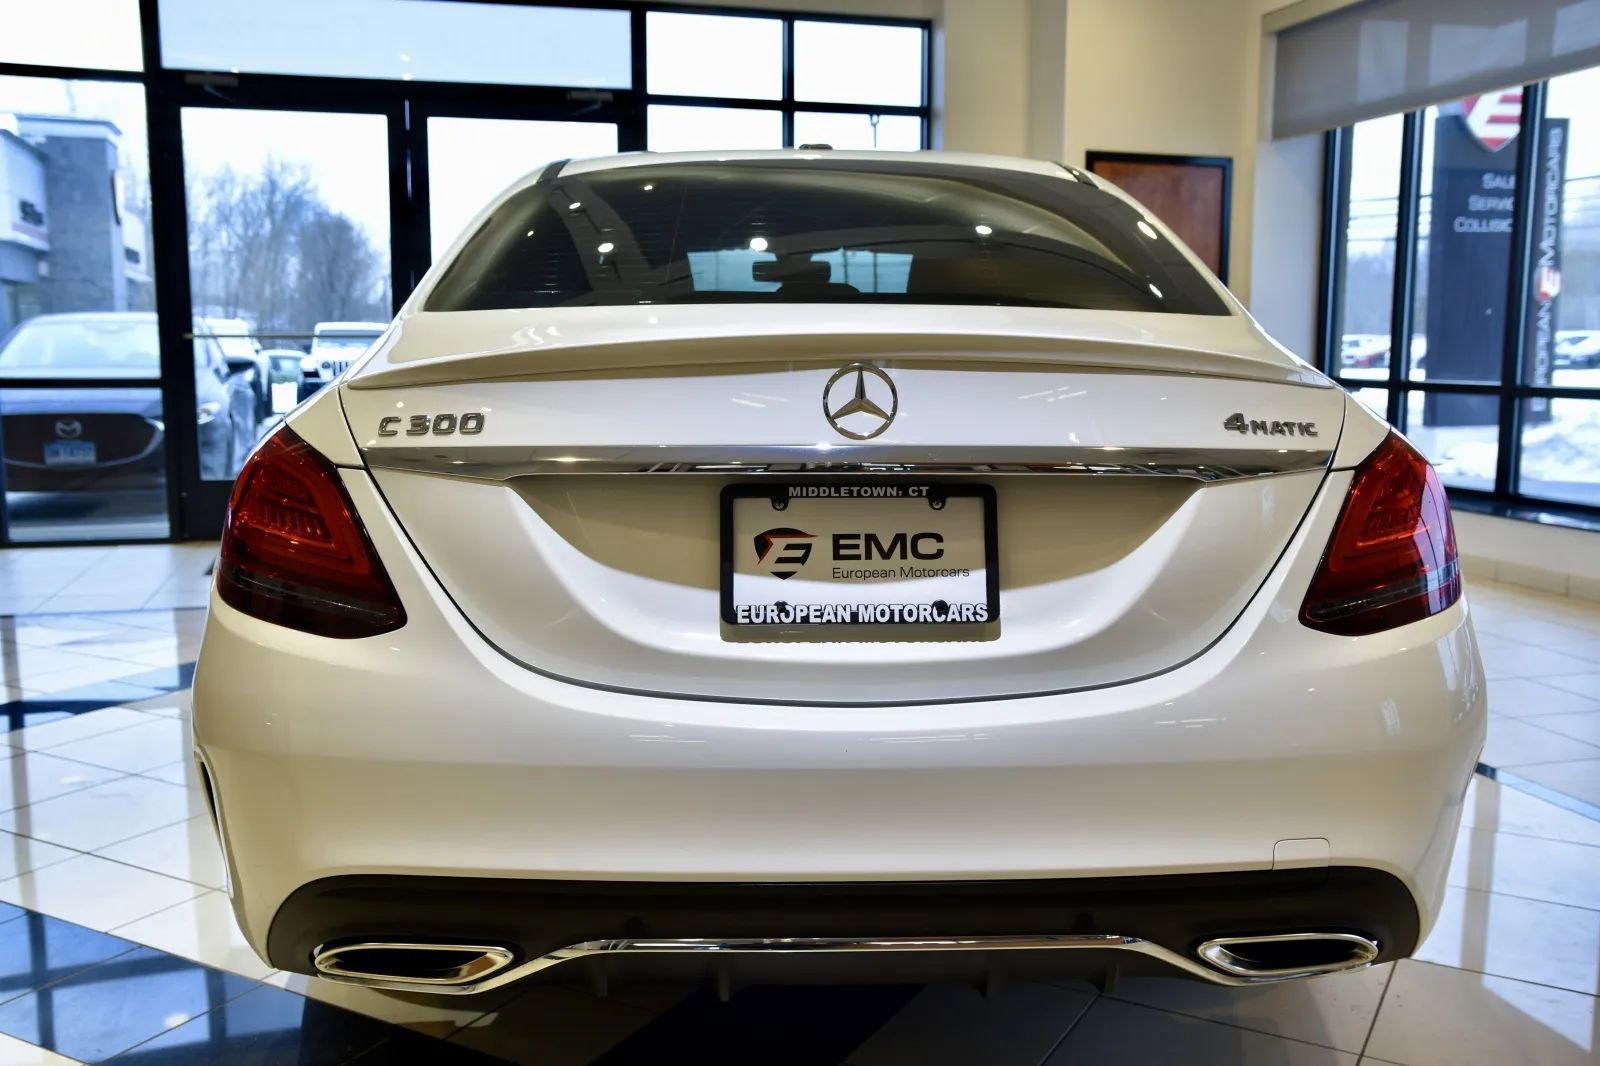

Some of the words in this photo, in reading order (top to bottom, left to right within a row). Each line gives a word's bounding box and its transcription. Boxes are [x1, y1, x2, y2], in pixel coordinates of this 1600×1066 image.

[1531, 301, 1552, 411] EROPEAN
[378, 416, 402, 436] C
[406, 413, 485, 436] 300
[1223, 412, 1319, 437] 4MATIC
[788, 486, 903, 498] MIDDLETOWN,
[908, 486, 930, 497] CT
[832, 532, 945, 561] EMC
[832, 567, 896, 580] European
[900, 566, 970, 579] Motorcars
[736, 603, 850, 624] EUROPEAN
[858, 602, 989, 624] MOTORCARS
